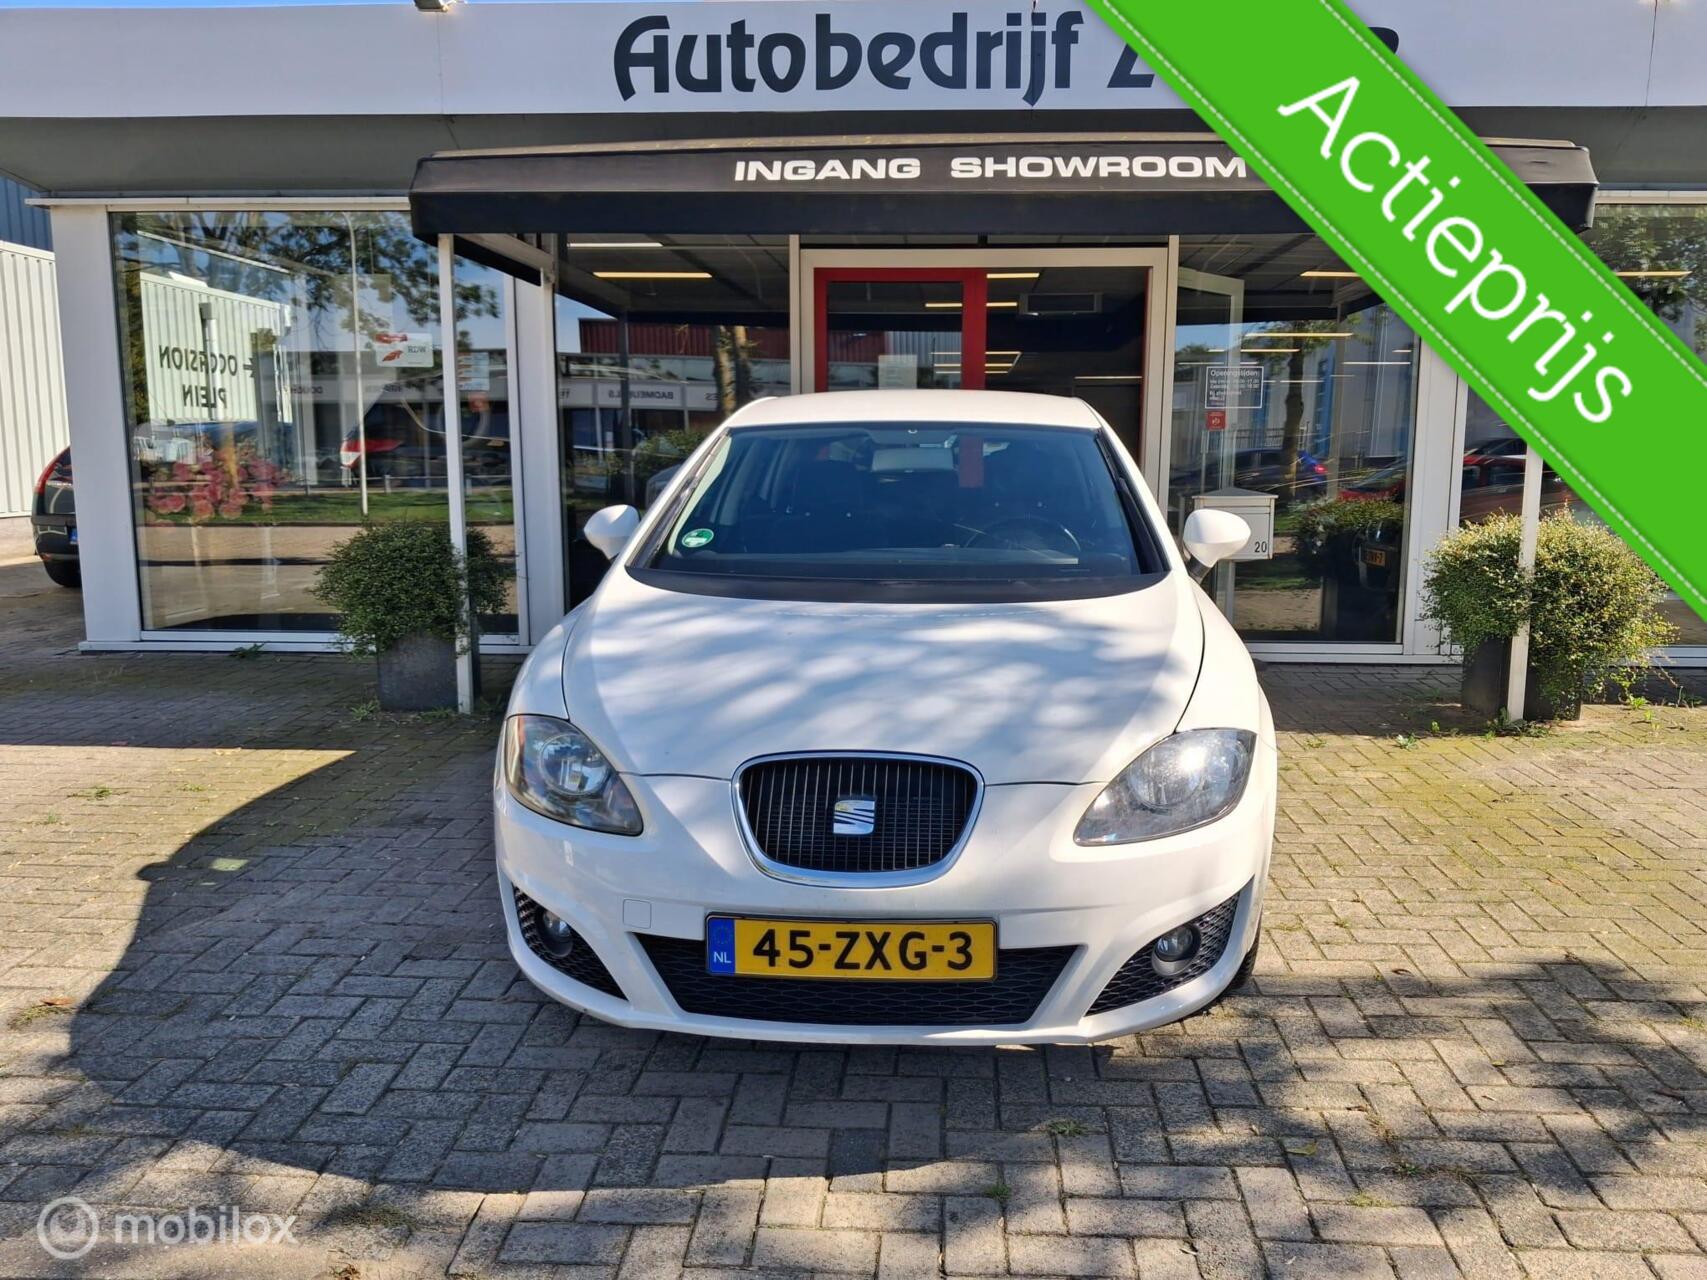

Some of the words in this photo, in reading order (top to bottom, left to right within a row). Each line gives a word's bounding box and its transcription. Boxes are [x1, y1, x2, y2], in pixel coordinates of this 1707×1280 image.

[613, 11, 1084, 106] Autobedrijf
[734, 157, 921, 181] INGANG
[950, 156, 1247, 179] SHOWROOM
[1254, 541, 1267, 553] 20
[713, 951, 731, 963] NL
[752, 928, 973, 971] 45-ZXG-3
